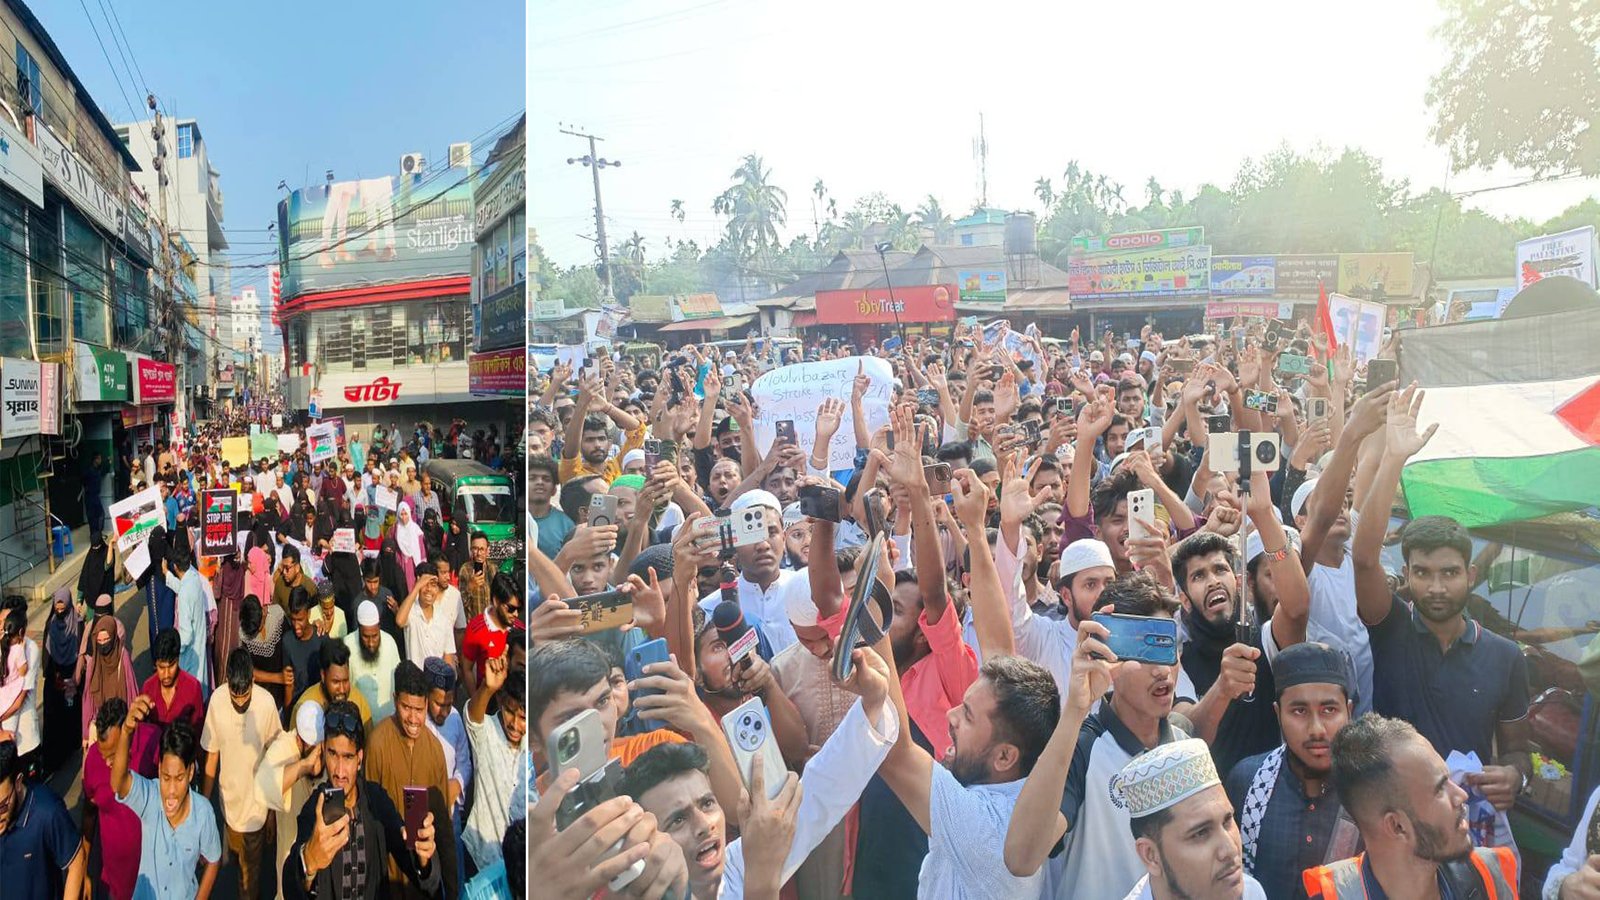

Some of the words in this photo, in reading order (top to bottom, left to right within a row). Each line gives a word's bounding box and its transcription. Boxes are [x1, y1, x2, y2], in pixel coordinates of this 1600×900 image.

[407, 222, 476, 251] Starlight
[1107, 232, 1162, 248] apollo
[5, 378, 38, 390] SUNNA
[344, 376, 402, 402] বাটা
[206, 512, 220, 524] STOP
[221, 511, 232, 523] THE
[205, 531, 233, 547] GAZA
